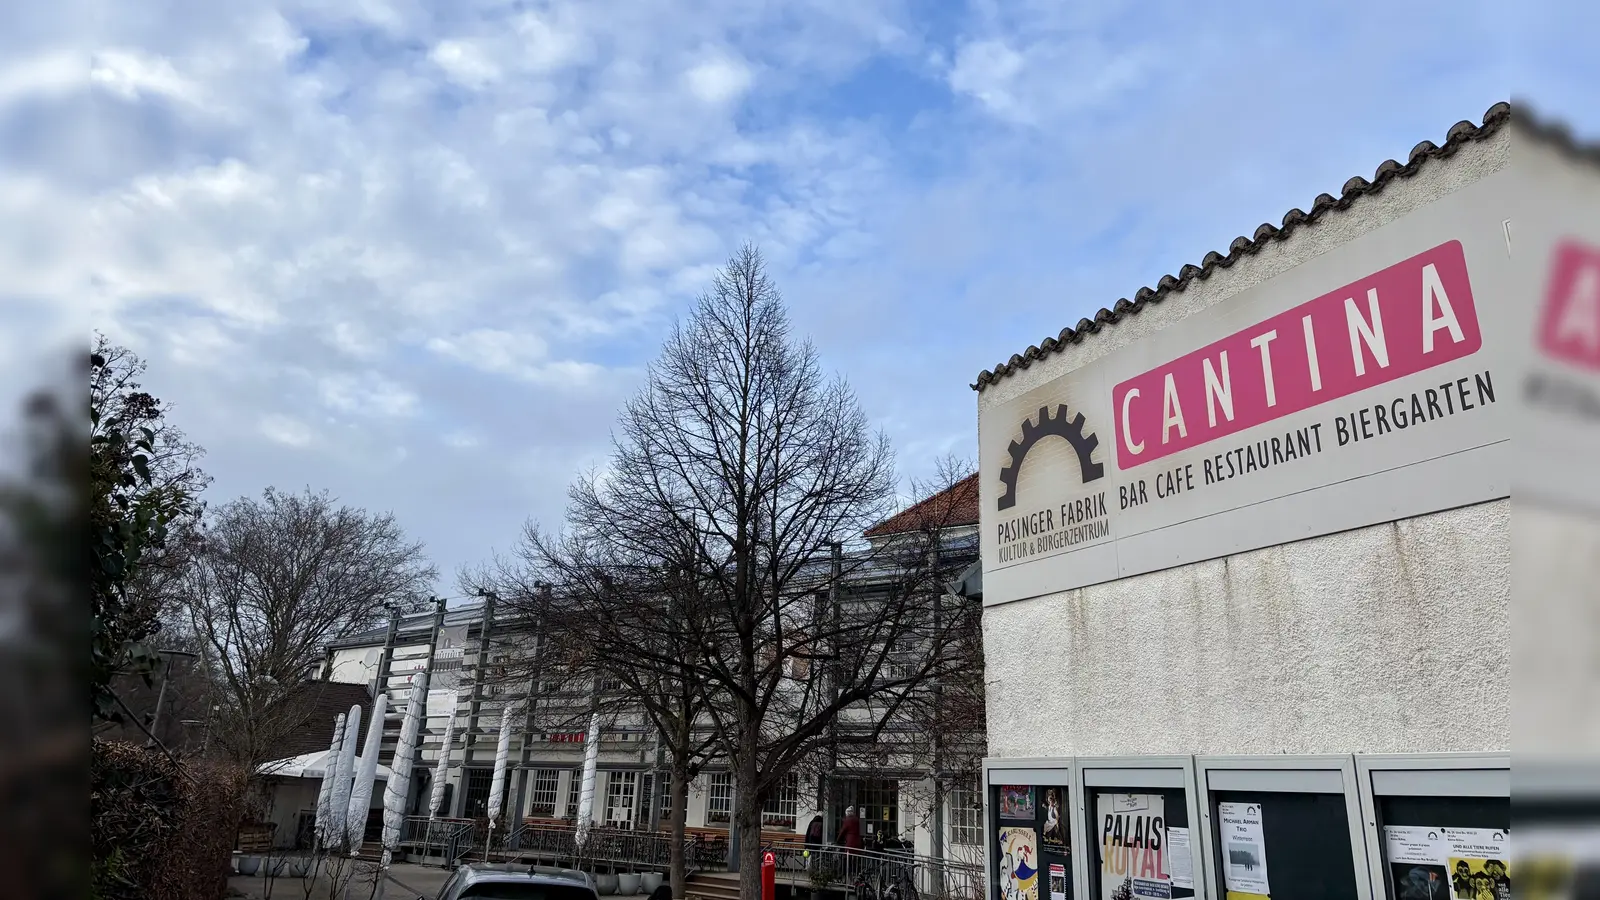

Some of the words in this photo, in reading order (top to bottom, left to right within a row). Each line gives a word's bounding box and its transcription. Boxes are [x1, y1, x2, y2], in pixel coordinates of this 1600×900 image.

[1121, 262, 1467, 455] CANTINA
[1119, 476, 1149, 511] BAR
[1156, 464, 1195, 503] CAFE
[1204, 424, 1323, 487] RESTAURANT
[1335, 370, 1497, 447] BIERGARTEN
[998, 509, 1054, 545] PASINGER
[1061, 491, 1107, 527] FABRIK
[998, 541, 1028, 563] KULTUR
[1029, 542, 1036, 556] &
[1037, 518, 1110, 554] BÜRGERZENTRUM
[1103, 813, 1163, 851] PALAIS
[1103, 835, 1168, 880] ROYAL
